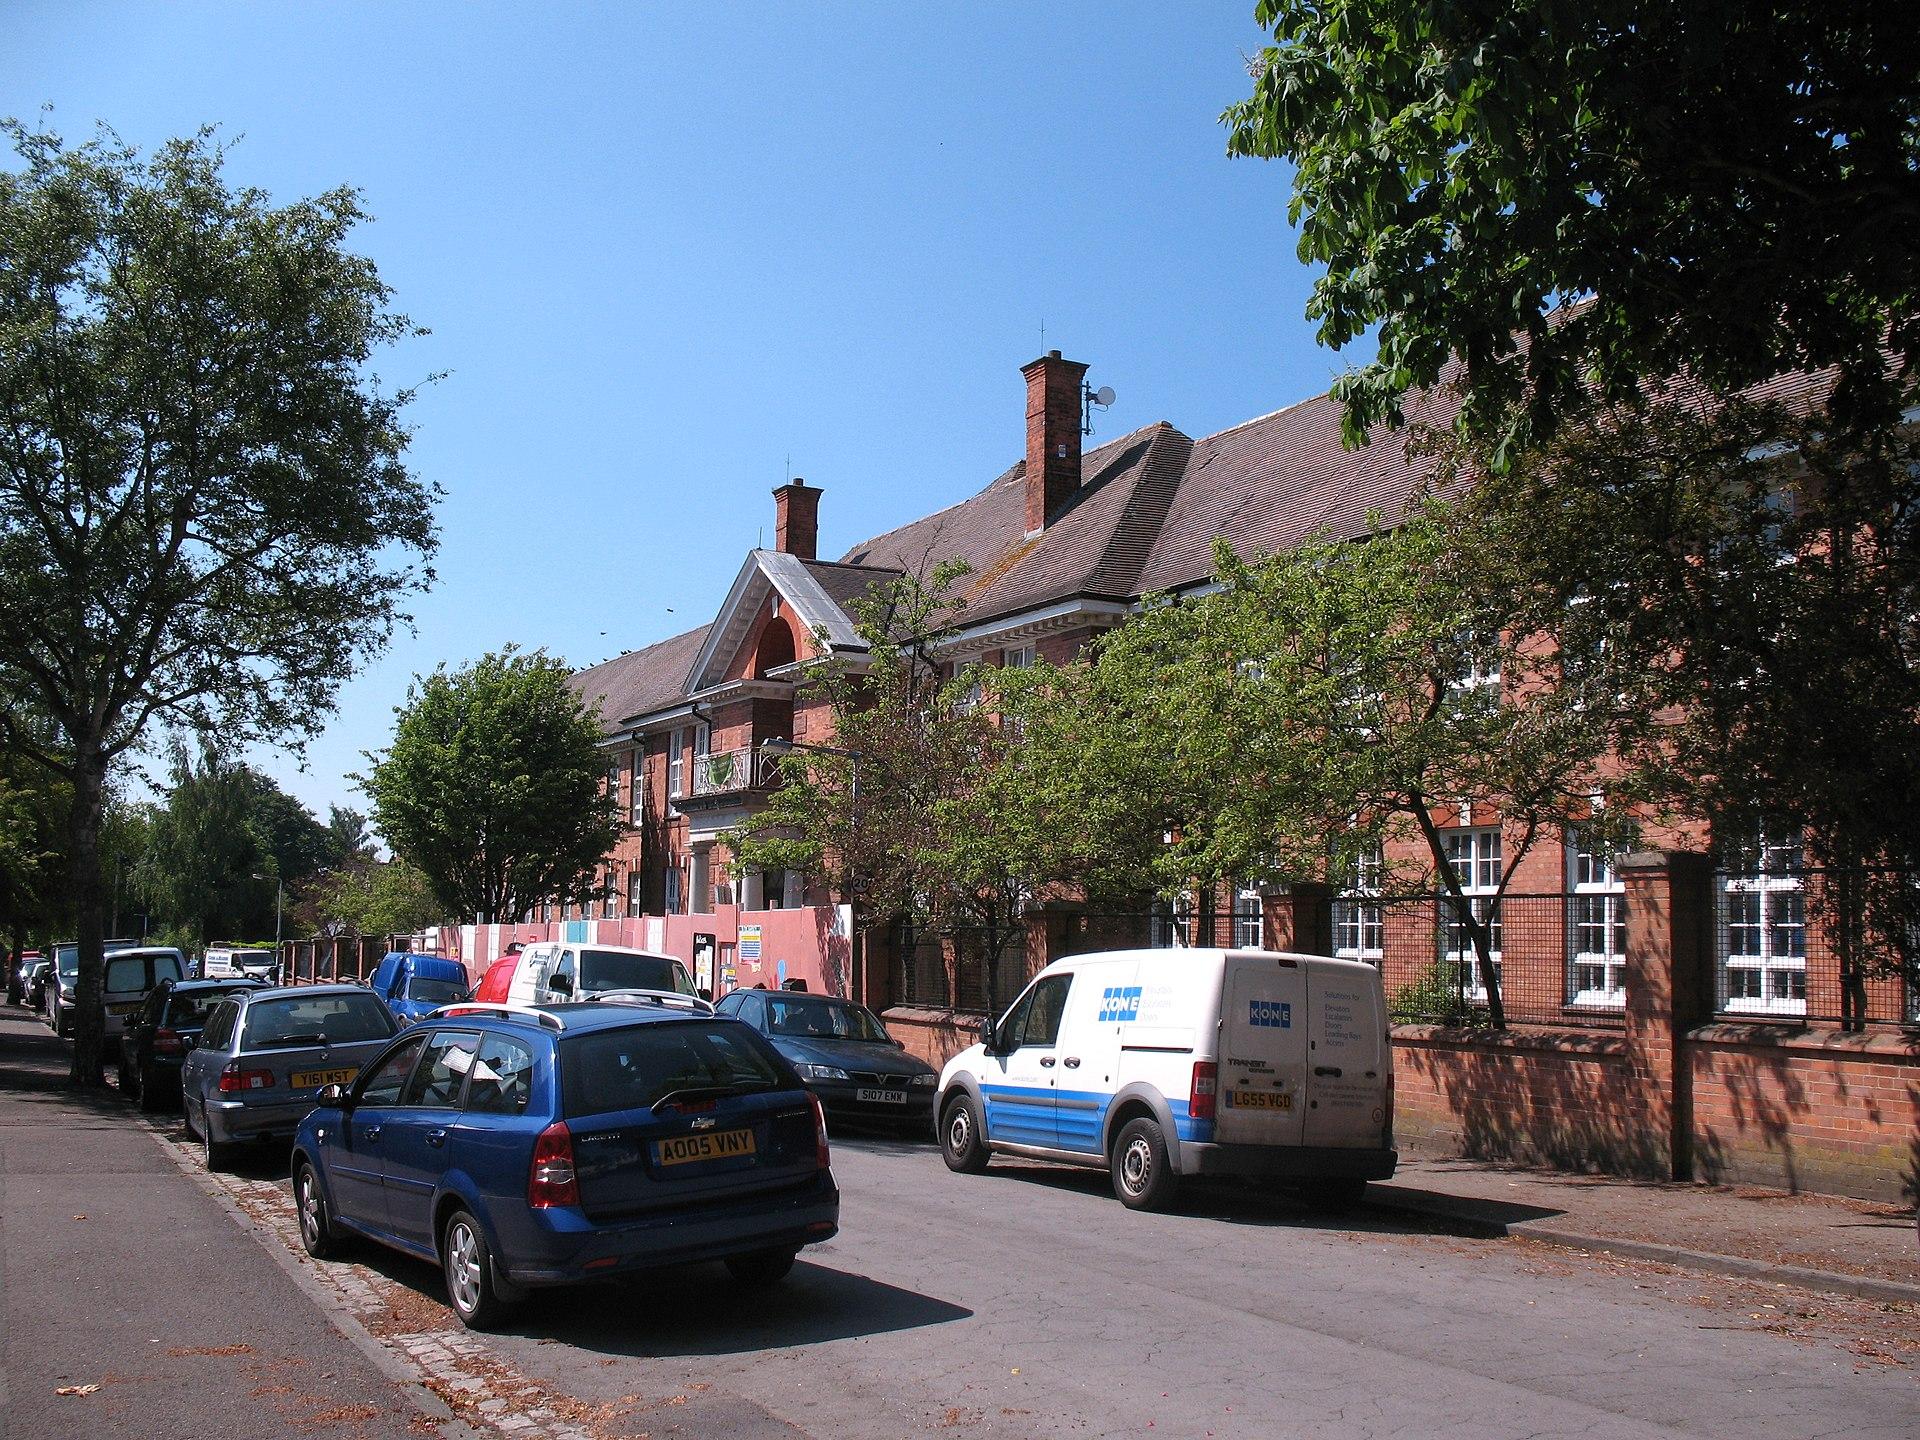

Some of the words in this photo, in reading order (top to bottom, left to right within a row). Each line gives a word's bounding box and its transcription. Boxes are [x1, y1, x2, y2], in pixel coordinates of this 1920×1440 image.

[854, 878, 868, 888] 20
[1100, 996, 1140, 1011] KONE
[1250, 1007, 1290, 1021] KONE
[1234, 1092, 1265, 1106] LG55
[1268, 1093, 1291, 1108] VGD
[714, 1130, 749, 1153] VNY
